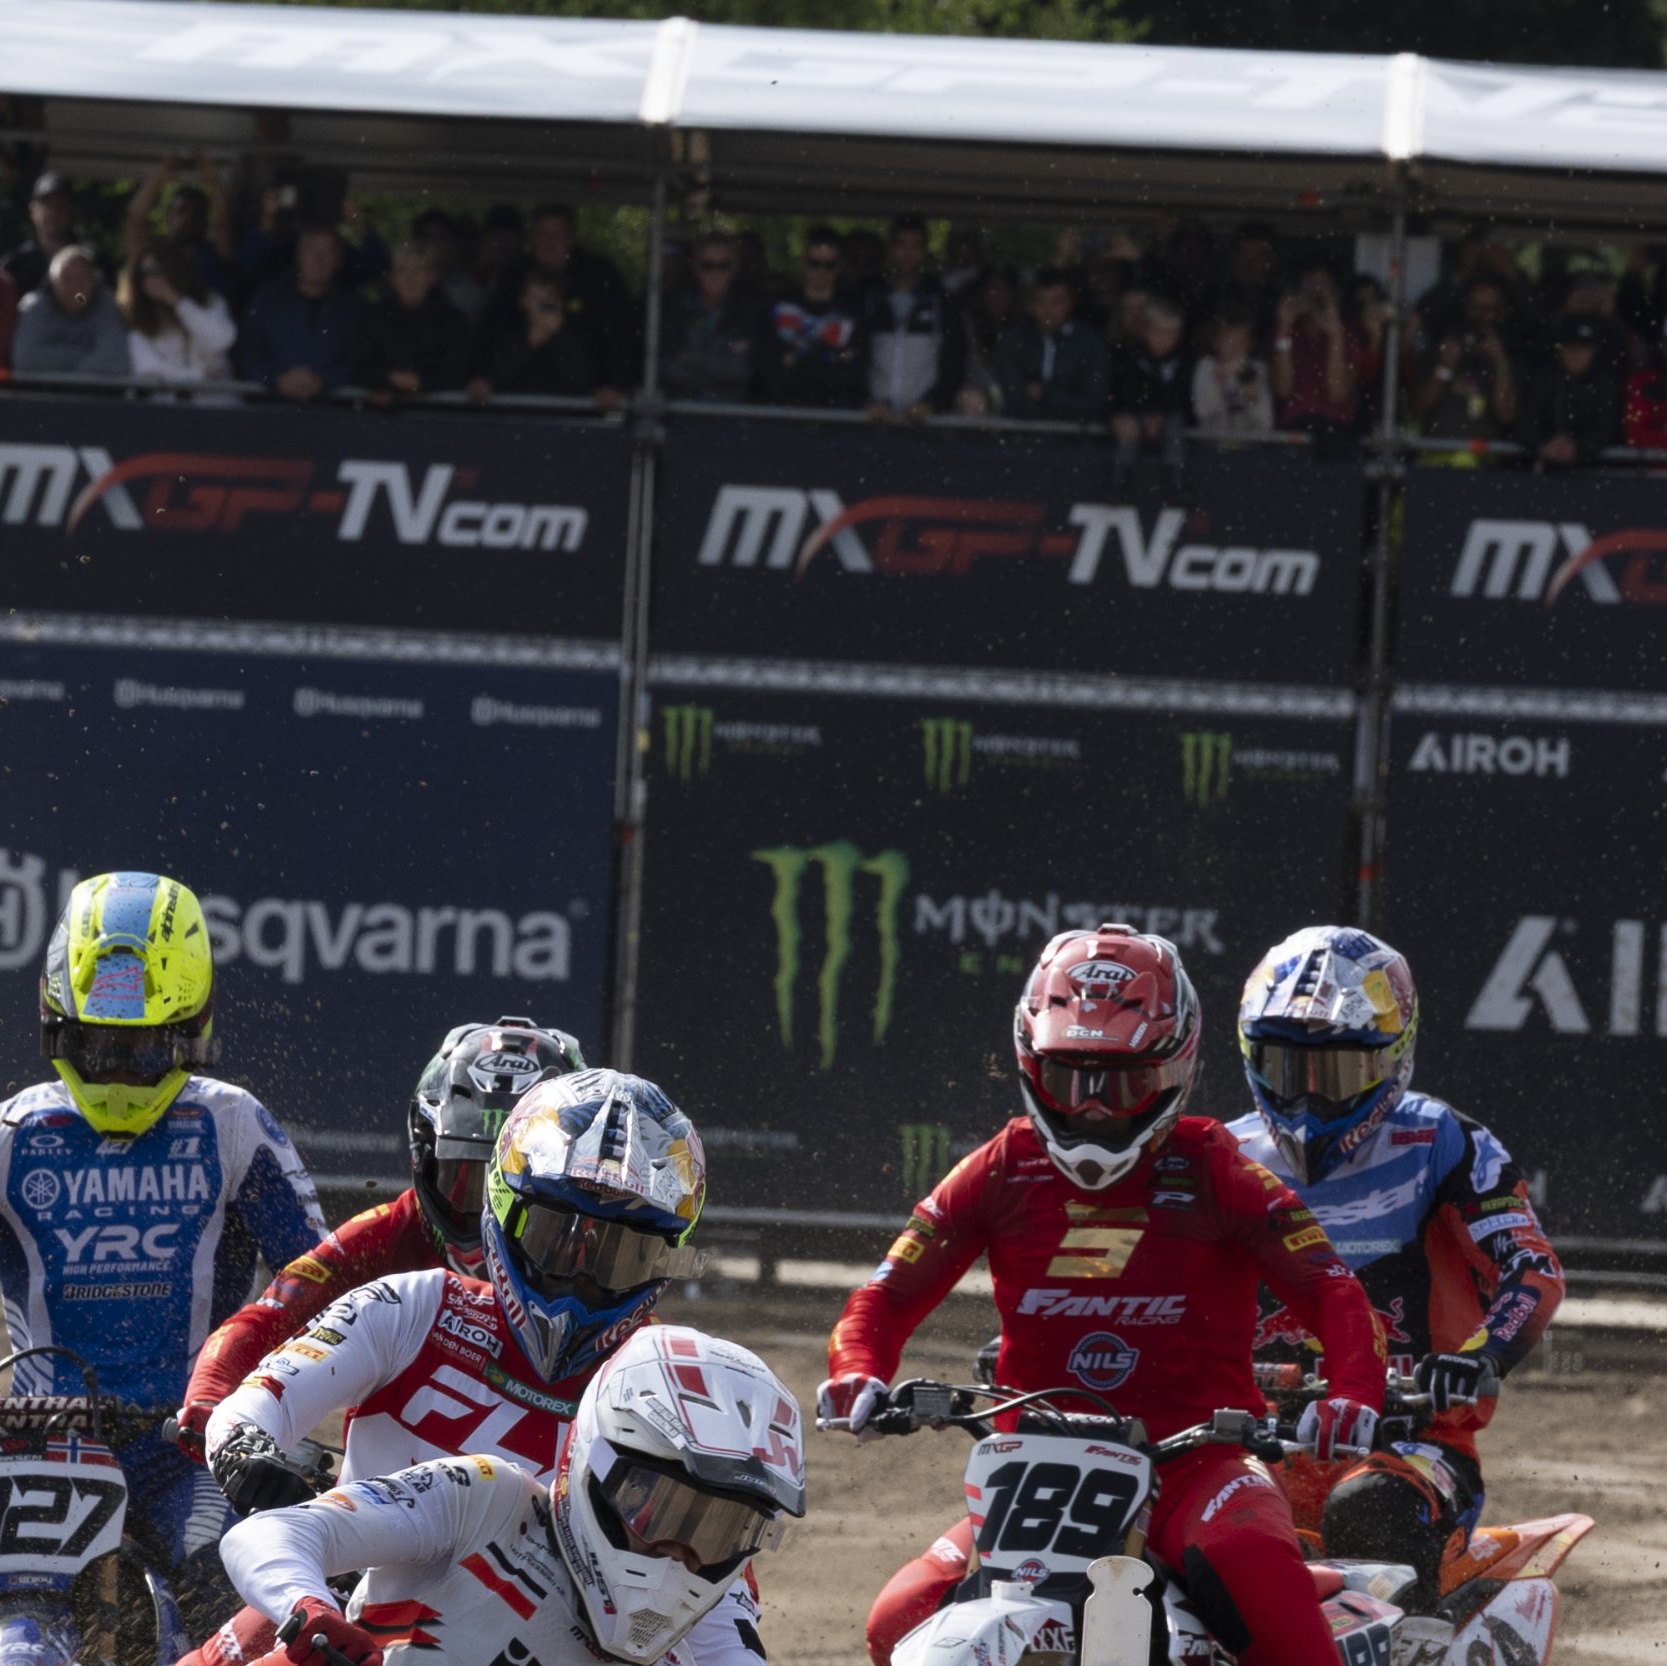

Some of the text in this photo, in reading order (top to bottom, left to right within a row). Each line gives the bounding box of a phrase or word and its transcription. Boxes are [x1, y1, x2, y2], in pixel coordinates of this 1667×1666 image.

[1409, 733, 1571, 778] AIROH
[1071, 962, 1135, 985] Arai
[1465, 914, 1667, 1038] AI
[475, 1052, 541, 1075] Arai
[63, 1164, 210, 1206] YAMAHA
[37, 1205, 201, 1222] RACING
[54, 1222, 182, 1264] YRC
[63, 1261, 171, 1277] HIGH PERFORMANCE
[64, 1281, 172, 1300] BRIDGESTONE
[1016, 1288, 1187, 1317] FANTIC
[1114, 1315, 1181, 1326] RACING
[440, 1312, 503, 1359] AIROH
[458, 1344, 483, 1364] BOER
[1071, 1351, 1134, 1370] NILS
[505, 1379, 574, 1416] MOTOREX
[977, 1440, 1024, 1456] MXGP
[1084, 1444, 1144, 1467] FANTIC
[976, 1461, 1140, 1560] 189
[1014, 1564, 1049, 1579] NILS
